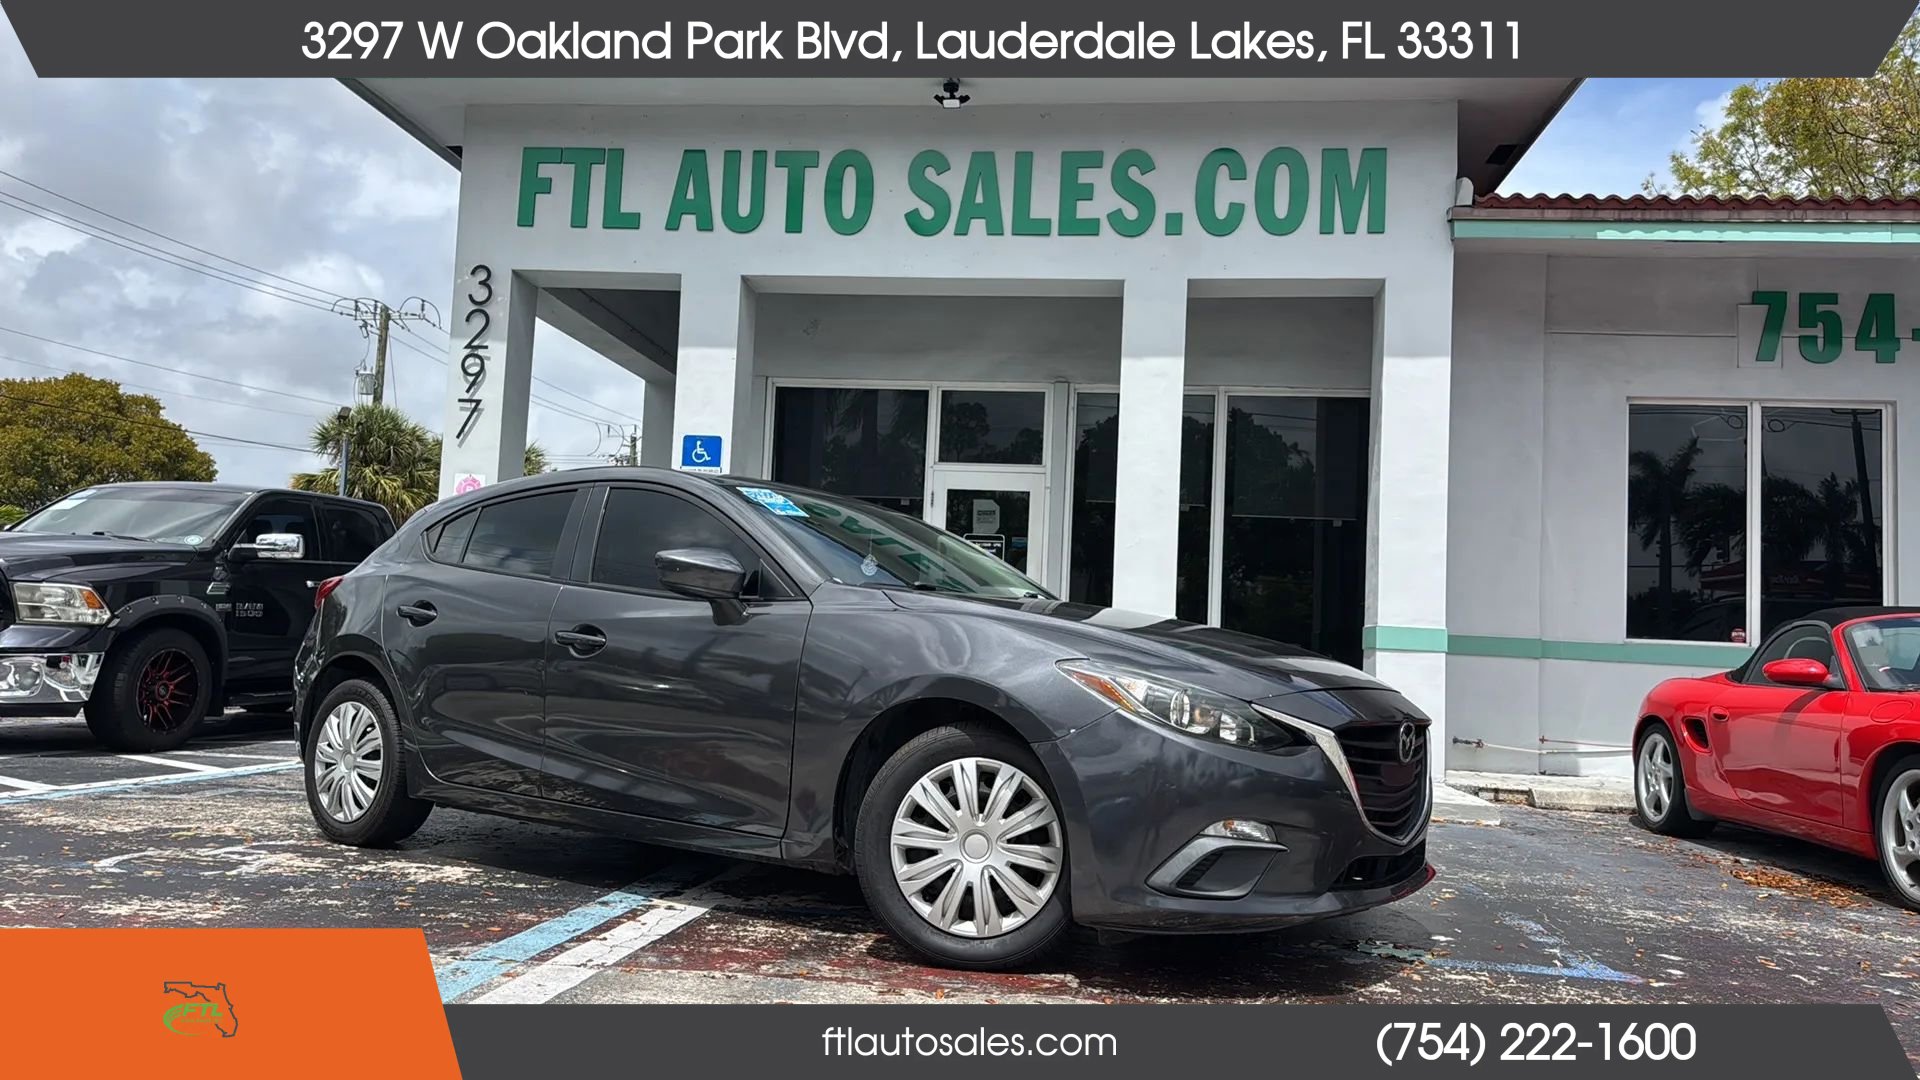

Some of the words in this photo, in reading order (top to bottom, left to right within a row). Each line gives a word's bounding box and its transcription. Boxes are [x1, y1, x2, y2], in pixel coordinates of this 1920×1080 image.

[517, 147, 641, 230] FTL
[664, 149, 875, 236] AUTO
[905, 147, 1388, 238] SALES.COM
[456, 264, 493, 440] 3297
